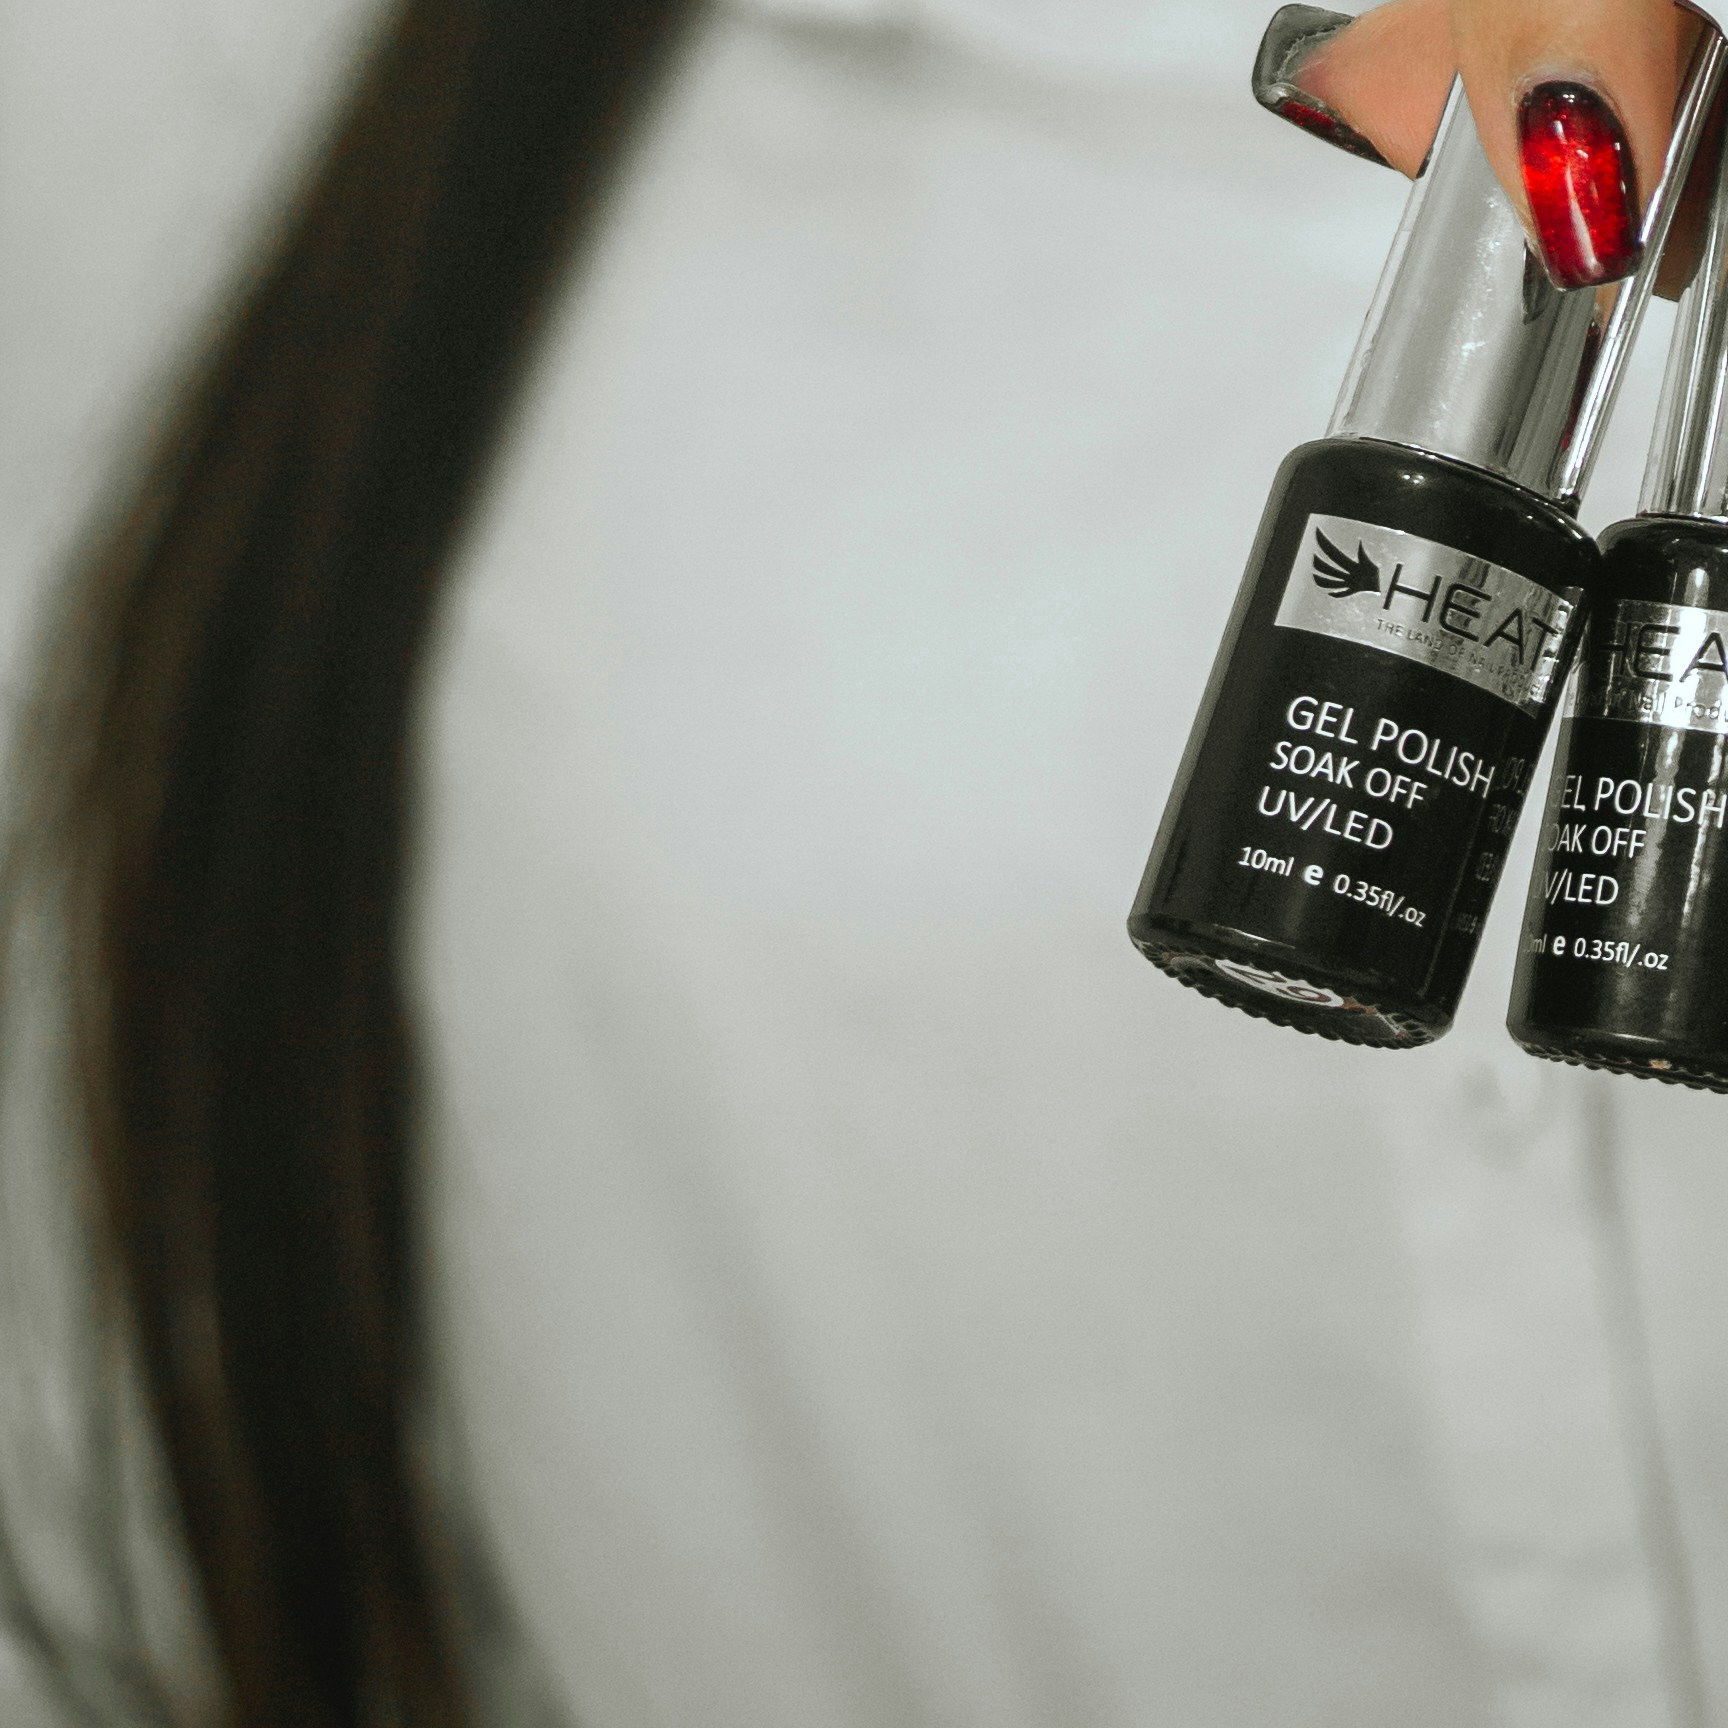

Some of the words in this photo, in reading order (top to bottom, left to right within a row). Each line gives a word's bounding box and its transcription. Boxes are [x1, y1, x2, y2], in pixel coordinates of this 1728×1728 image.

[1382, 563, 1560, 672] HEAT
[1269, 741, 1360, 789] SOAK
[1365, 767, 1428, 809] OFF
[1287, 696, 1358, 744] GEL
[1370, 718, 1496, 799] POLISH
[1257, 785, 1394, 850] UV/LED
[1557, 774, 1586, 812] EL
[1594, 777, 1728, 829] POLISH
[1237, 846, 1295, 877] 10ml
[1548, 823, 1587, 853] OAK
[1591, 825, 1647, 859] OFF
[1544, 868, 1619, 905] V/LED
